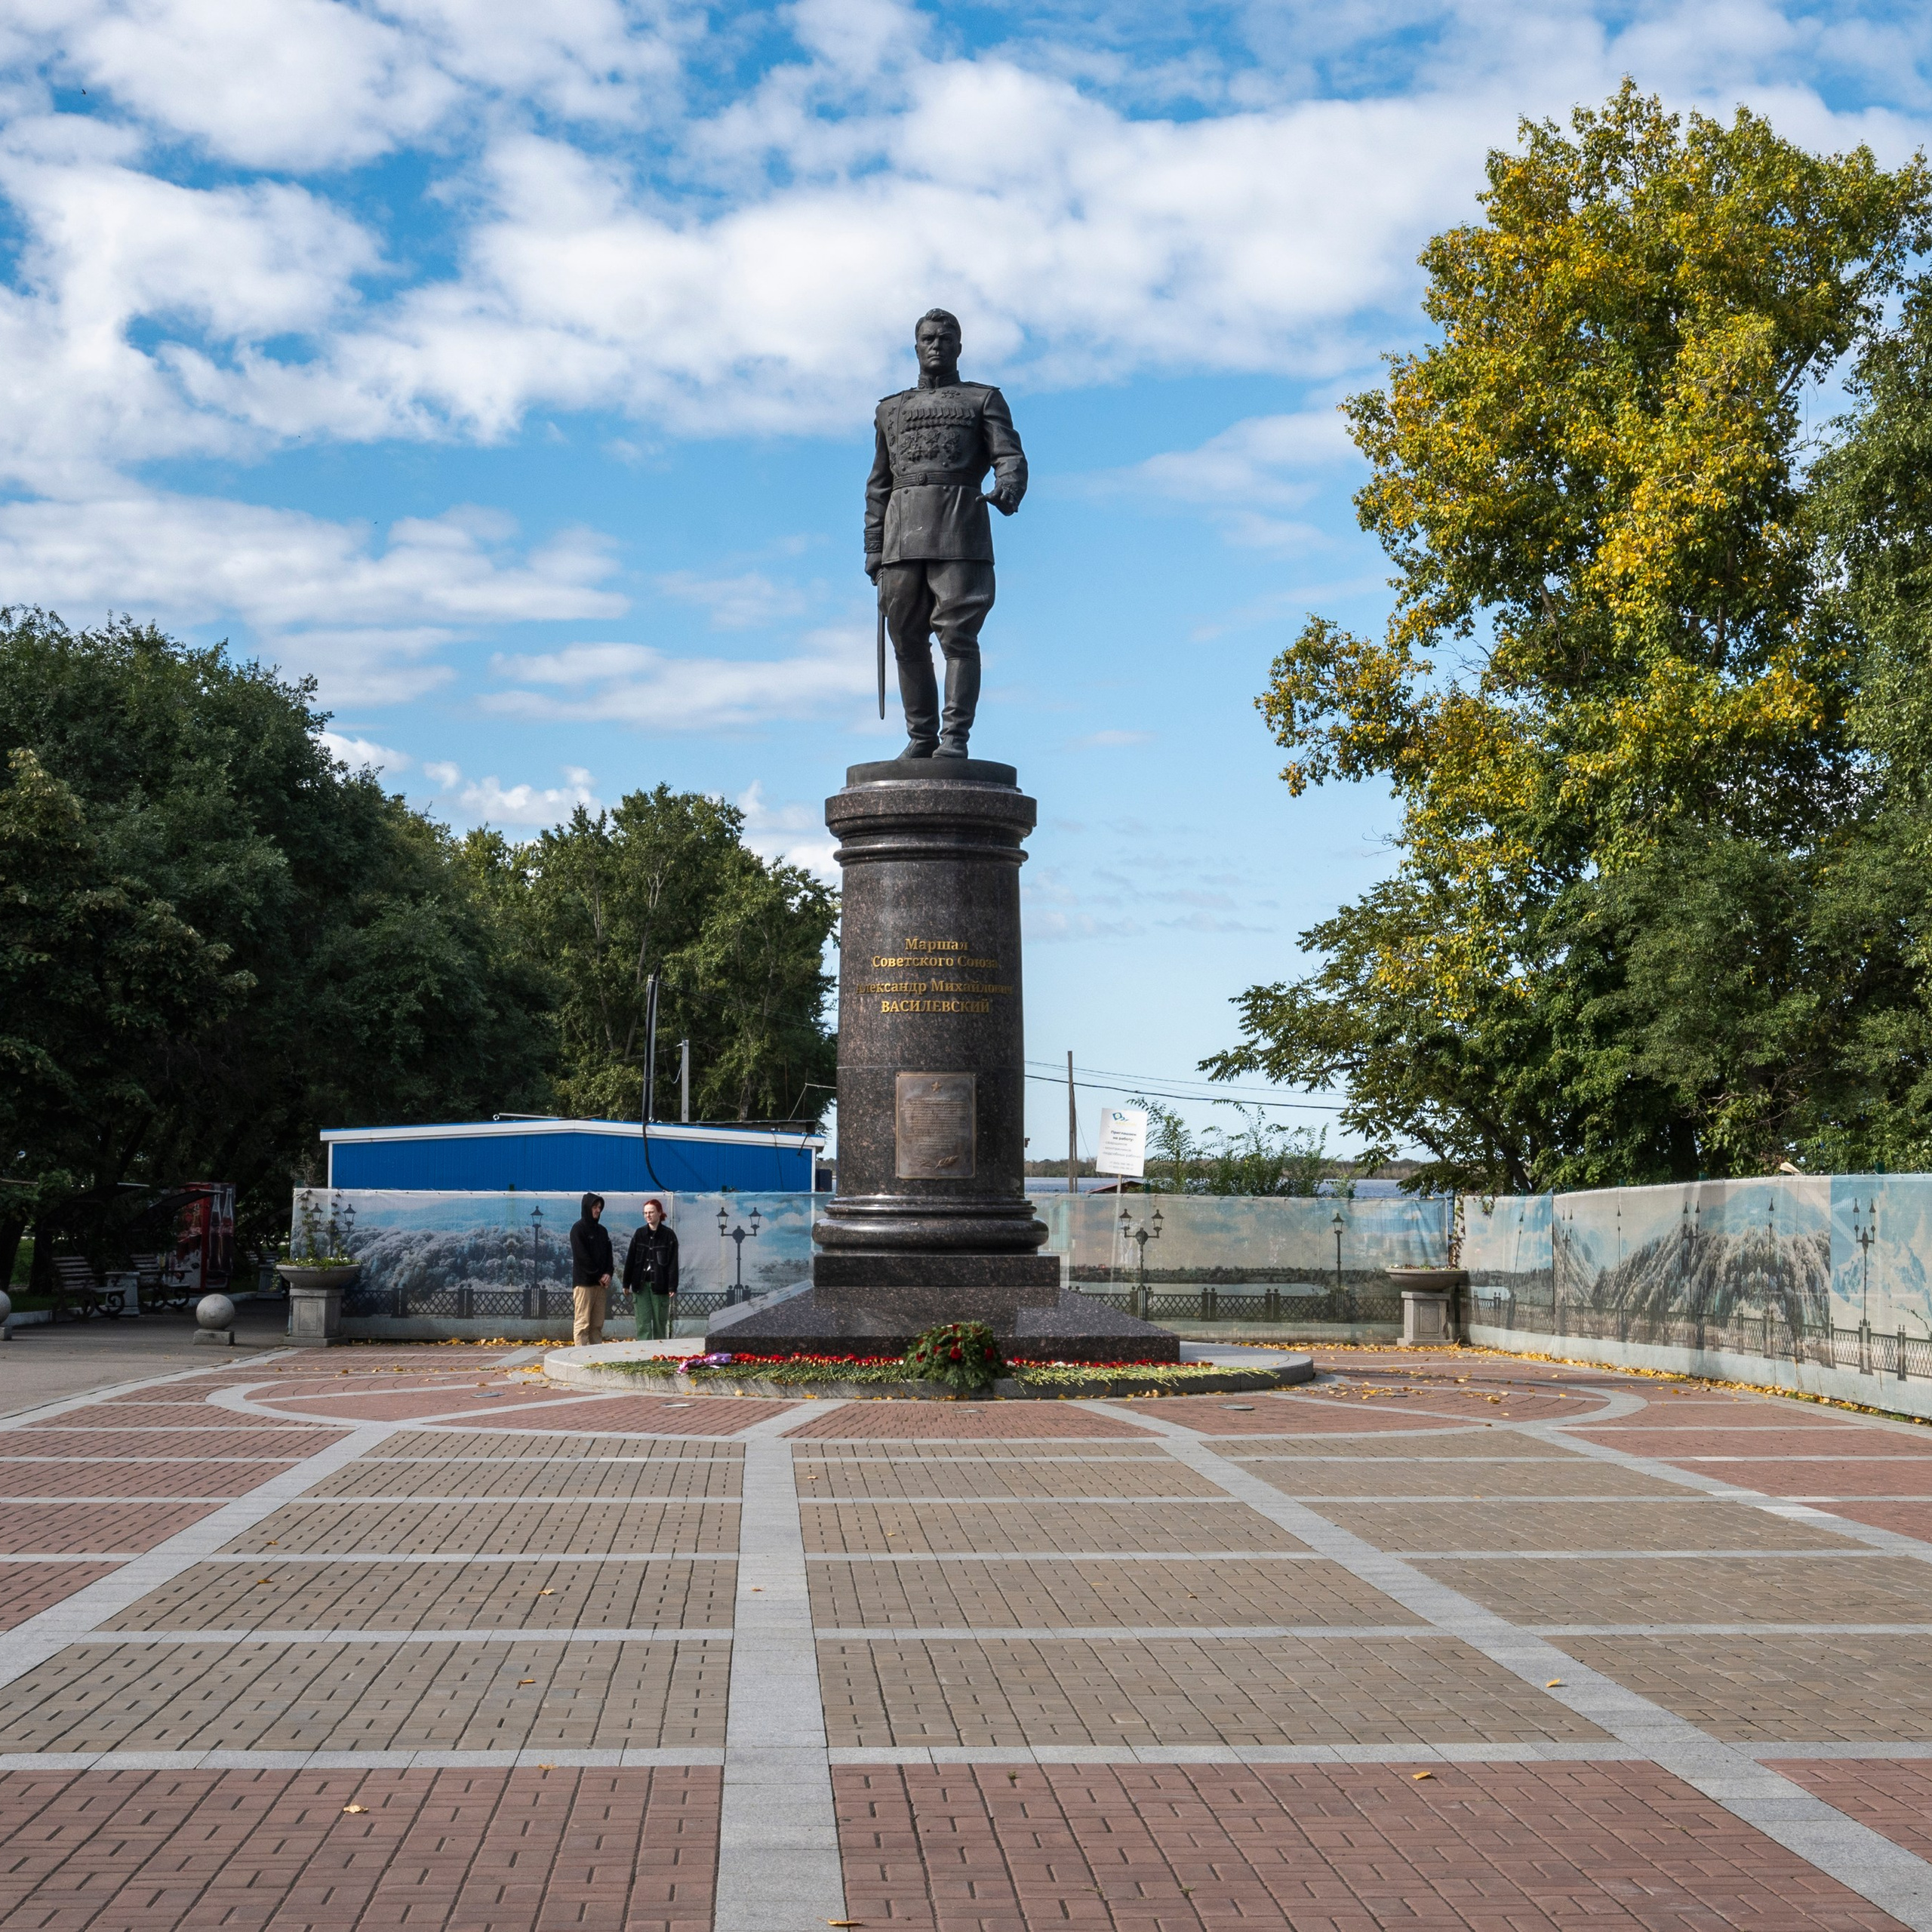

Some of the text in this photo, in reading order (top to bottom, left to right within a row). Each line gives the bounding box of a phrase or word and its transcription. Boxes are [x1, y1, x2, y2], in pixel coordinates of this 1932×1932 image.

[905, 938, 968, 953] Маршал
[872, 955, 998, 969] Советского Союза
[856, 980, 1013, 995] Александр Михайлович
[881, 998, 990, 1014] ВАСИЛЕВСКИЙ
